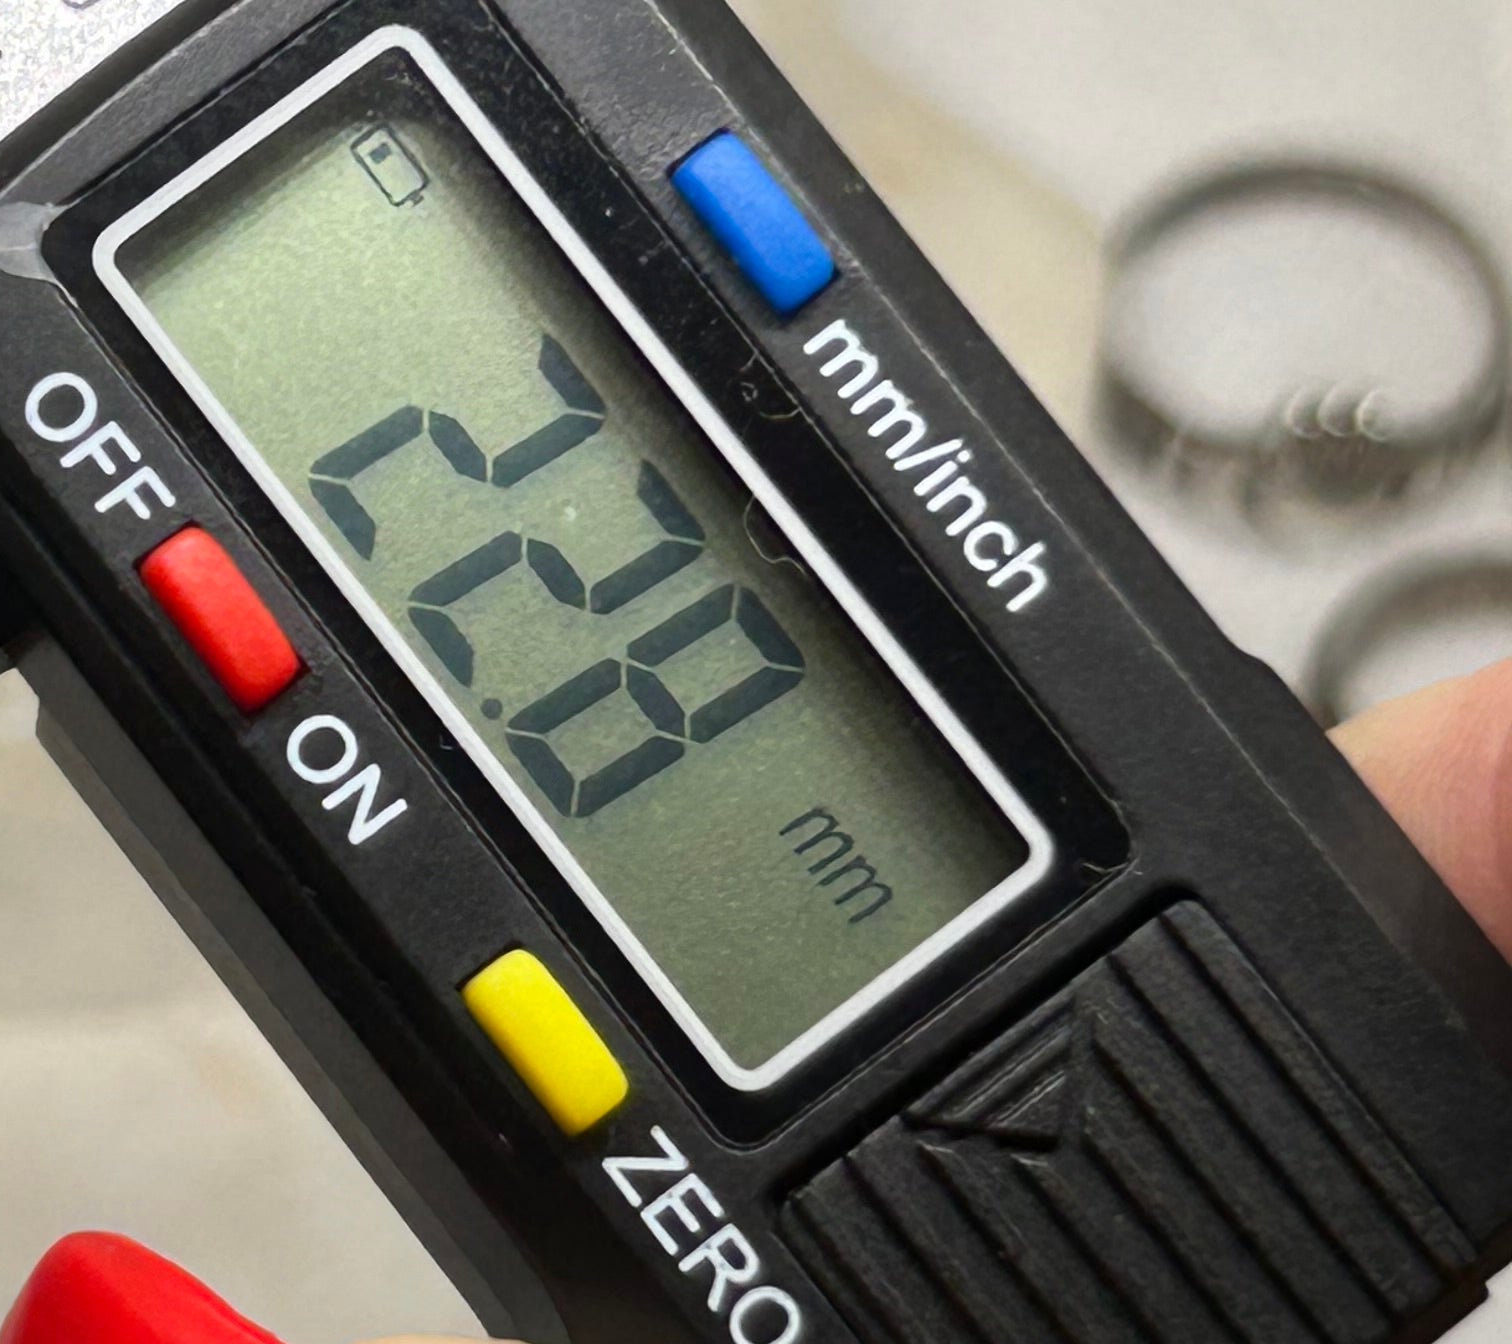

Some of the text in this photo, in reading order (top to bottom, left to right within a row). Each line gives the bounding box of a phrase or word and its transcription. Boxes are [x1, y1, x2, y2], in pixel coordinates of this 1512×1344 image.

[24, 372, 176, 521] OFF
[803, 319, 1049, 613] mm/inch
[308, 334, 895, 925] 22.8 mm
[286, 714, 408, 846] ON
